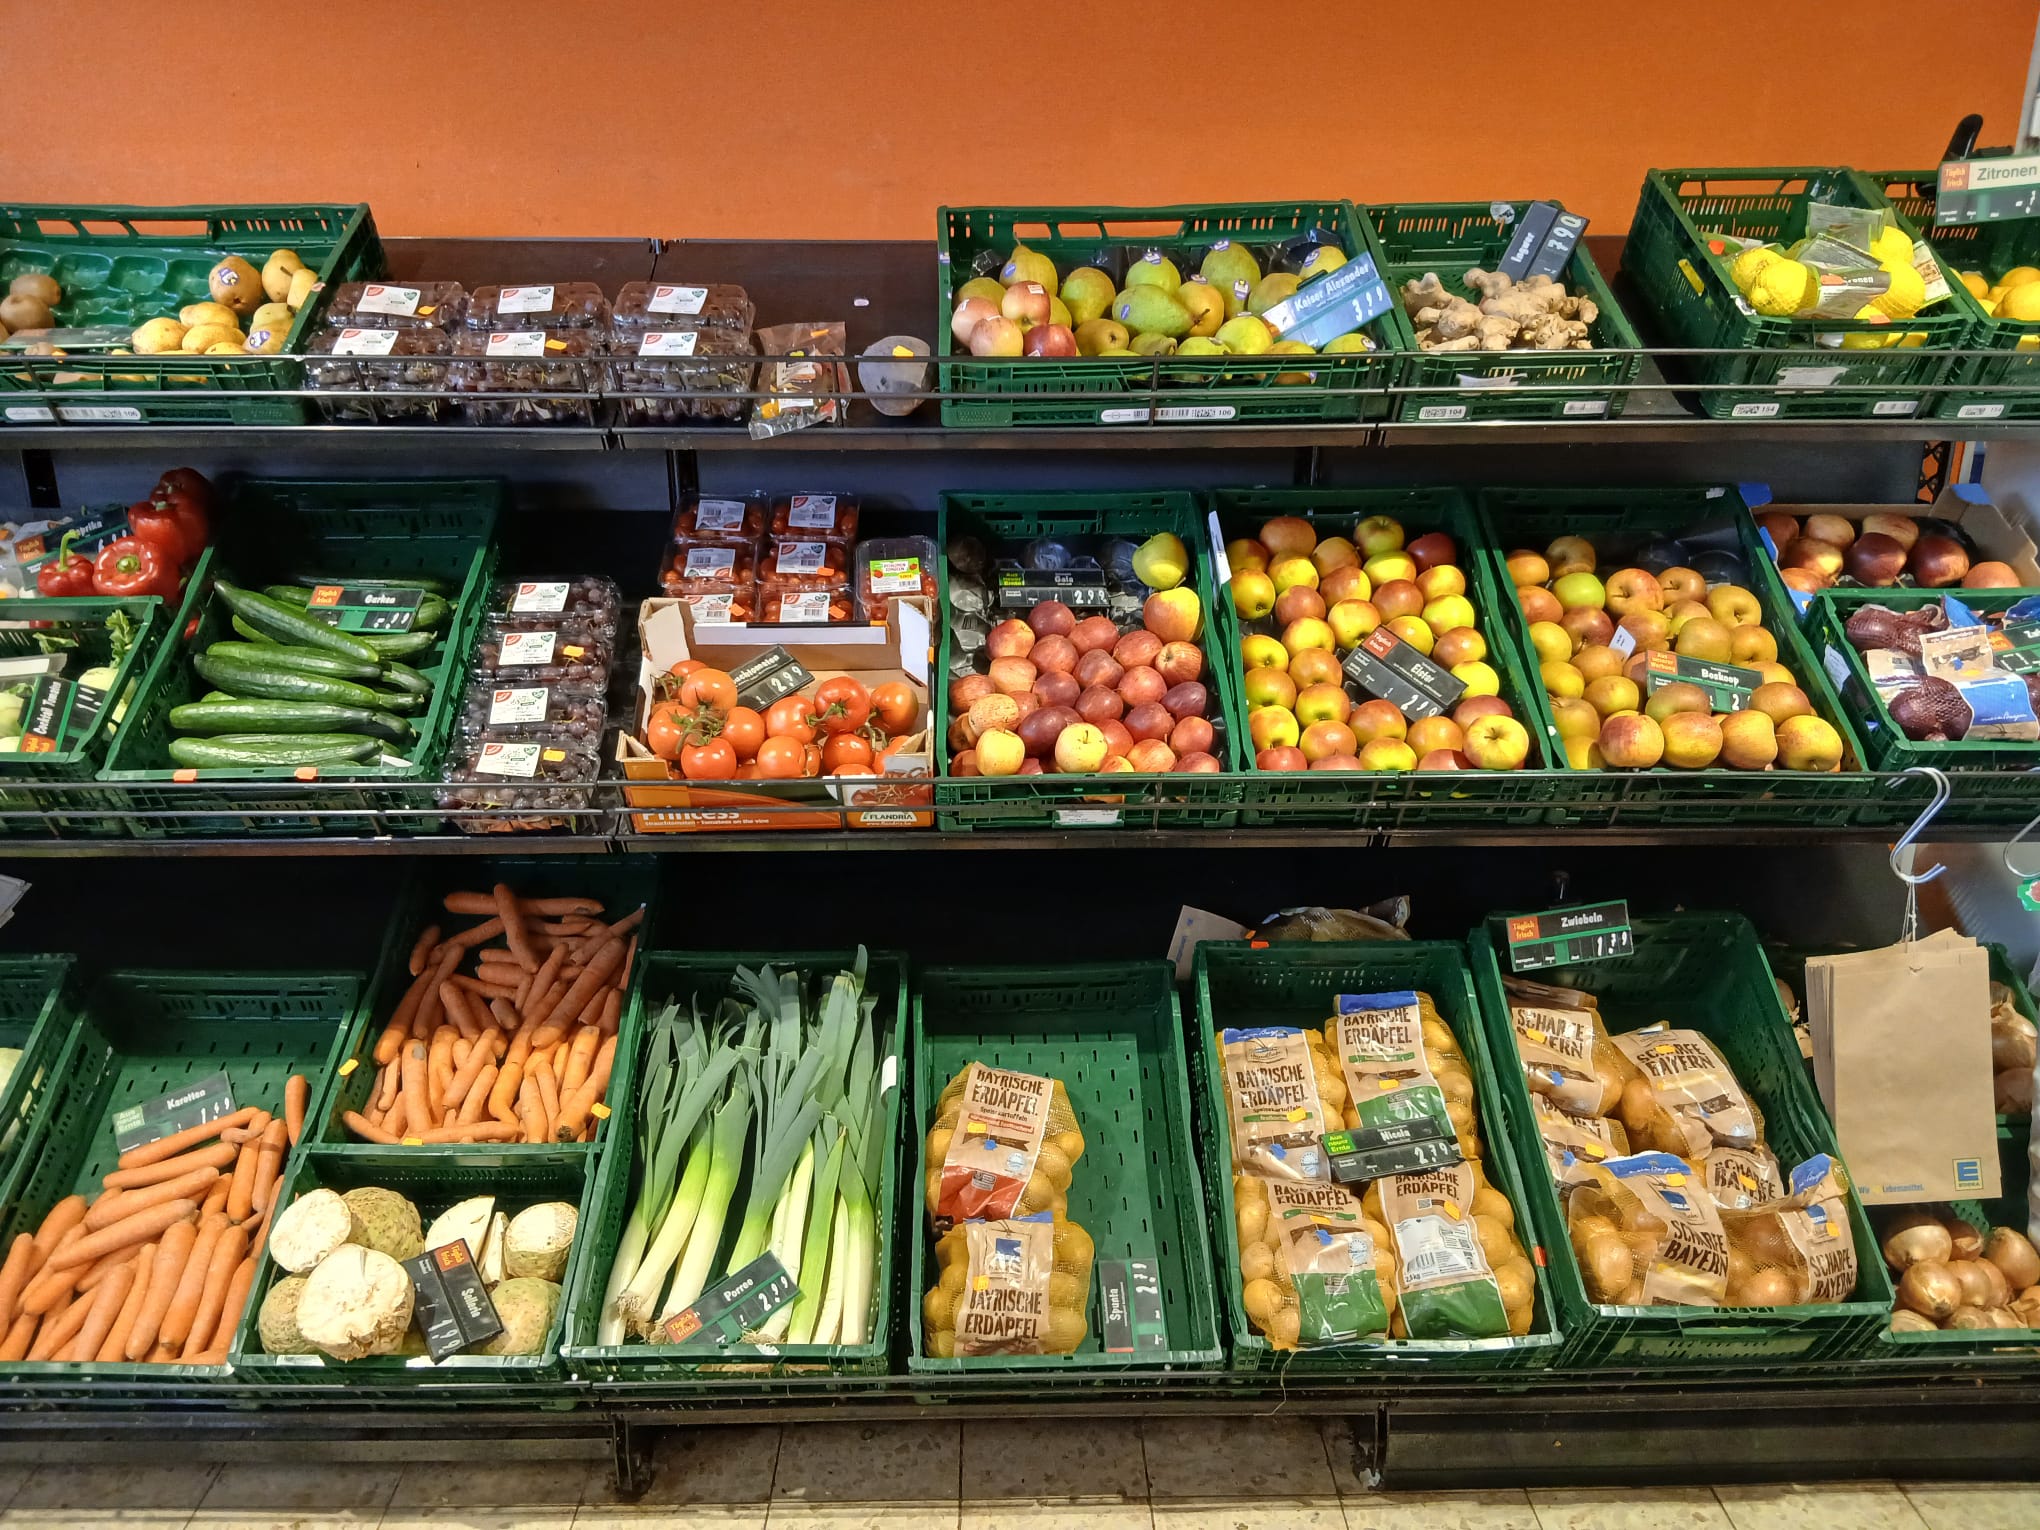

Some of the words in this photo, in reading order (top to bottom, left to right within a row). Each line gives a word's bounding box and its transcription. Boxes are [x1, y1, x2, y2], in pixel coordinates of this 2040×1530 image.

[1977, 165, 2038, 181] Zitronen
[1510, 232, 1535, 263] Ingwer
[1294, 290, 1324, 312] Kaiser
[1325, 263, 1369, 295] Alexander
[364, 594, 396, 604] Gurken
[1410, 663, 1435, 683] Elstar
[1701, 668, 1740, 688] Boskoop
[1513, 921, 1535, 930] Täglich
[1561, 912, 1603, 928] Zwiebeln
[1516, 930, 1534, 940] frisch
[166, 1089, 206, 1110] Karotten
[1380, 1128, 1411, 1142] Nicola
[440, 1250, 454, 1266] frisch
[451, 1244, 465, 1264] Täglich
[723, 1278, 754, 1302] Porree
[461, 1288, 482, 1318] Sellerie
[1110, 1288, 1121, 1321] Spunta
